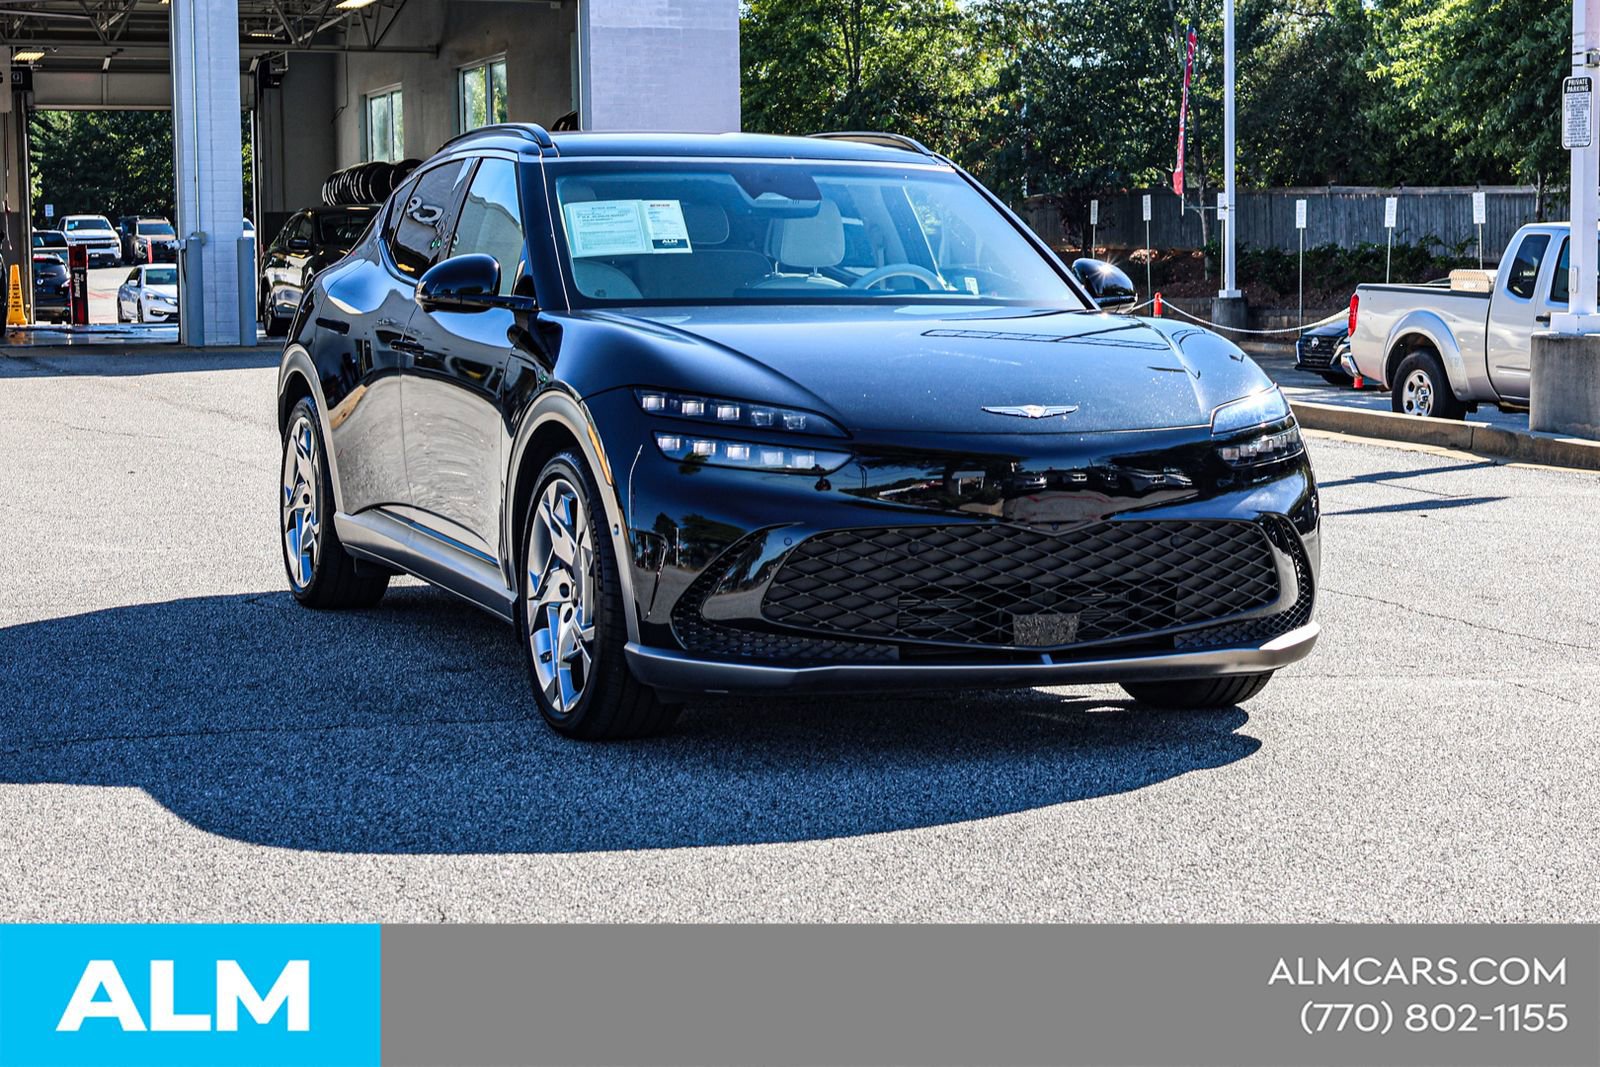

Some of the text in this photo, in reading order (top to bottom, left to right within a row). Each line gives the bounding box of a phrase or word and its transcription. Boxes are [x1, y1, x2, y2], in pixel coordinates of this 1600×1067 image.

[1568, 78, 1588, 86] PRIVATE
[1566, 85, 1589, 93] PARKING
[592, 520, 602, 586] MICHELIN
